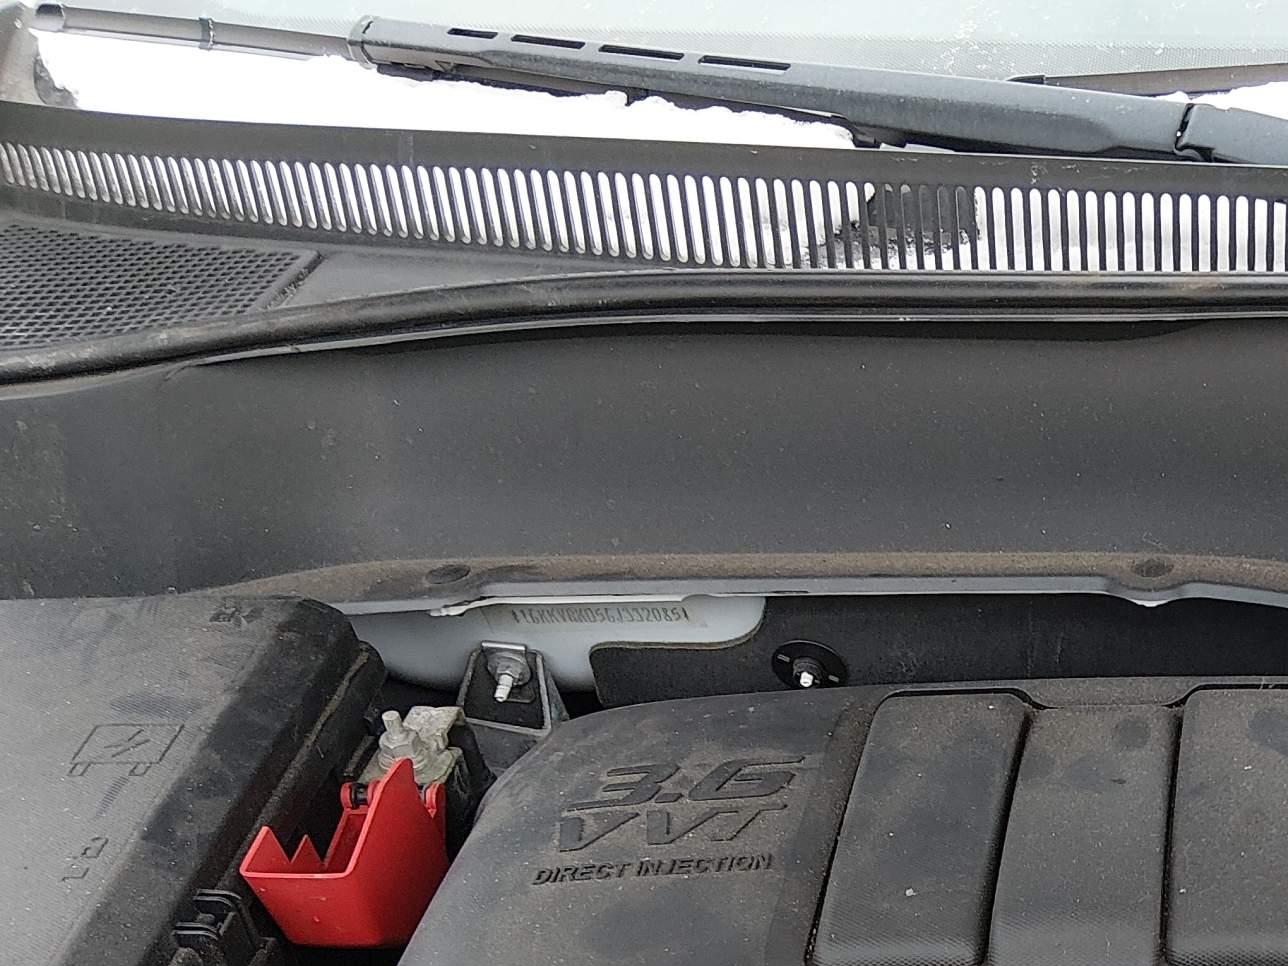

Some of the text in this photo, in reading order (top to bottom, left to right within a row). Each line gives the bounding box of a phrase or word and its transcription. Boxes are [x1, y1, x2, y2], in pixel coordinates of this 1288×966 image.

[566, 756, 805, 812] 3.6
[559, 804, 788, 853] VVT
[532, 853, 774, 885] DIRECT INJECTION
